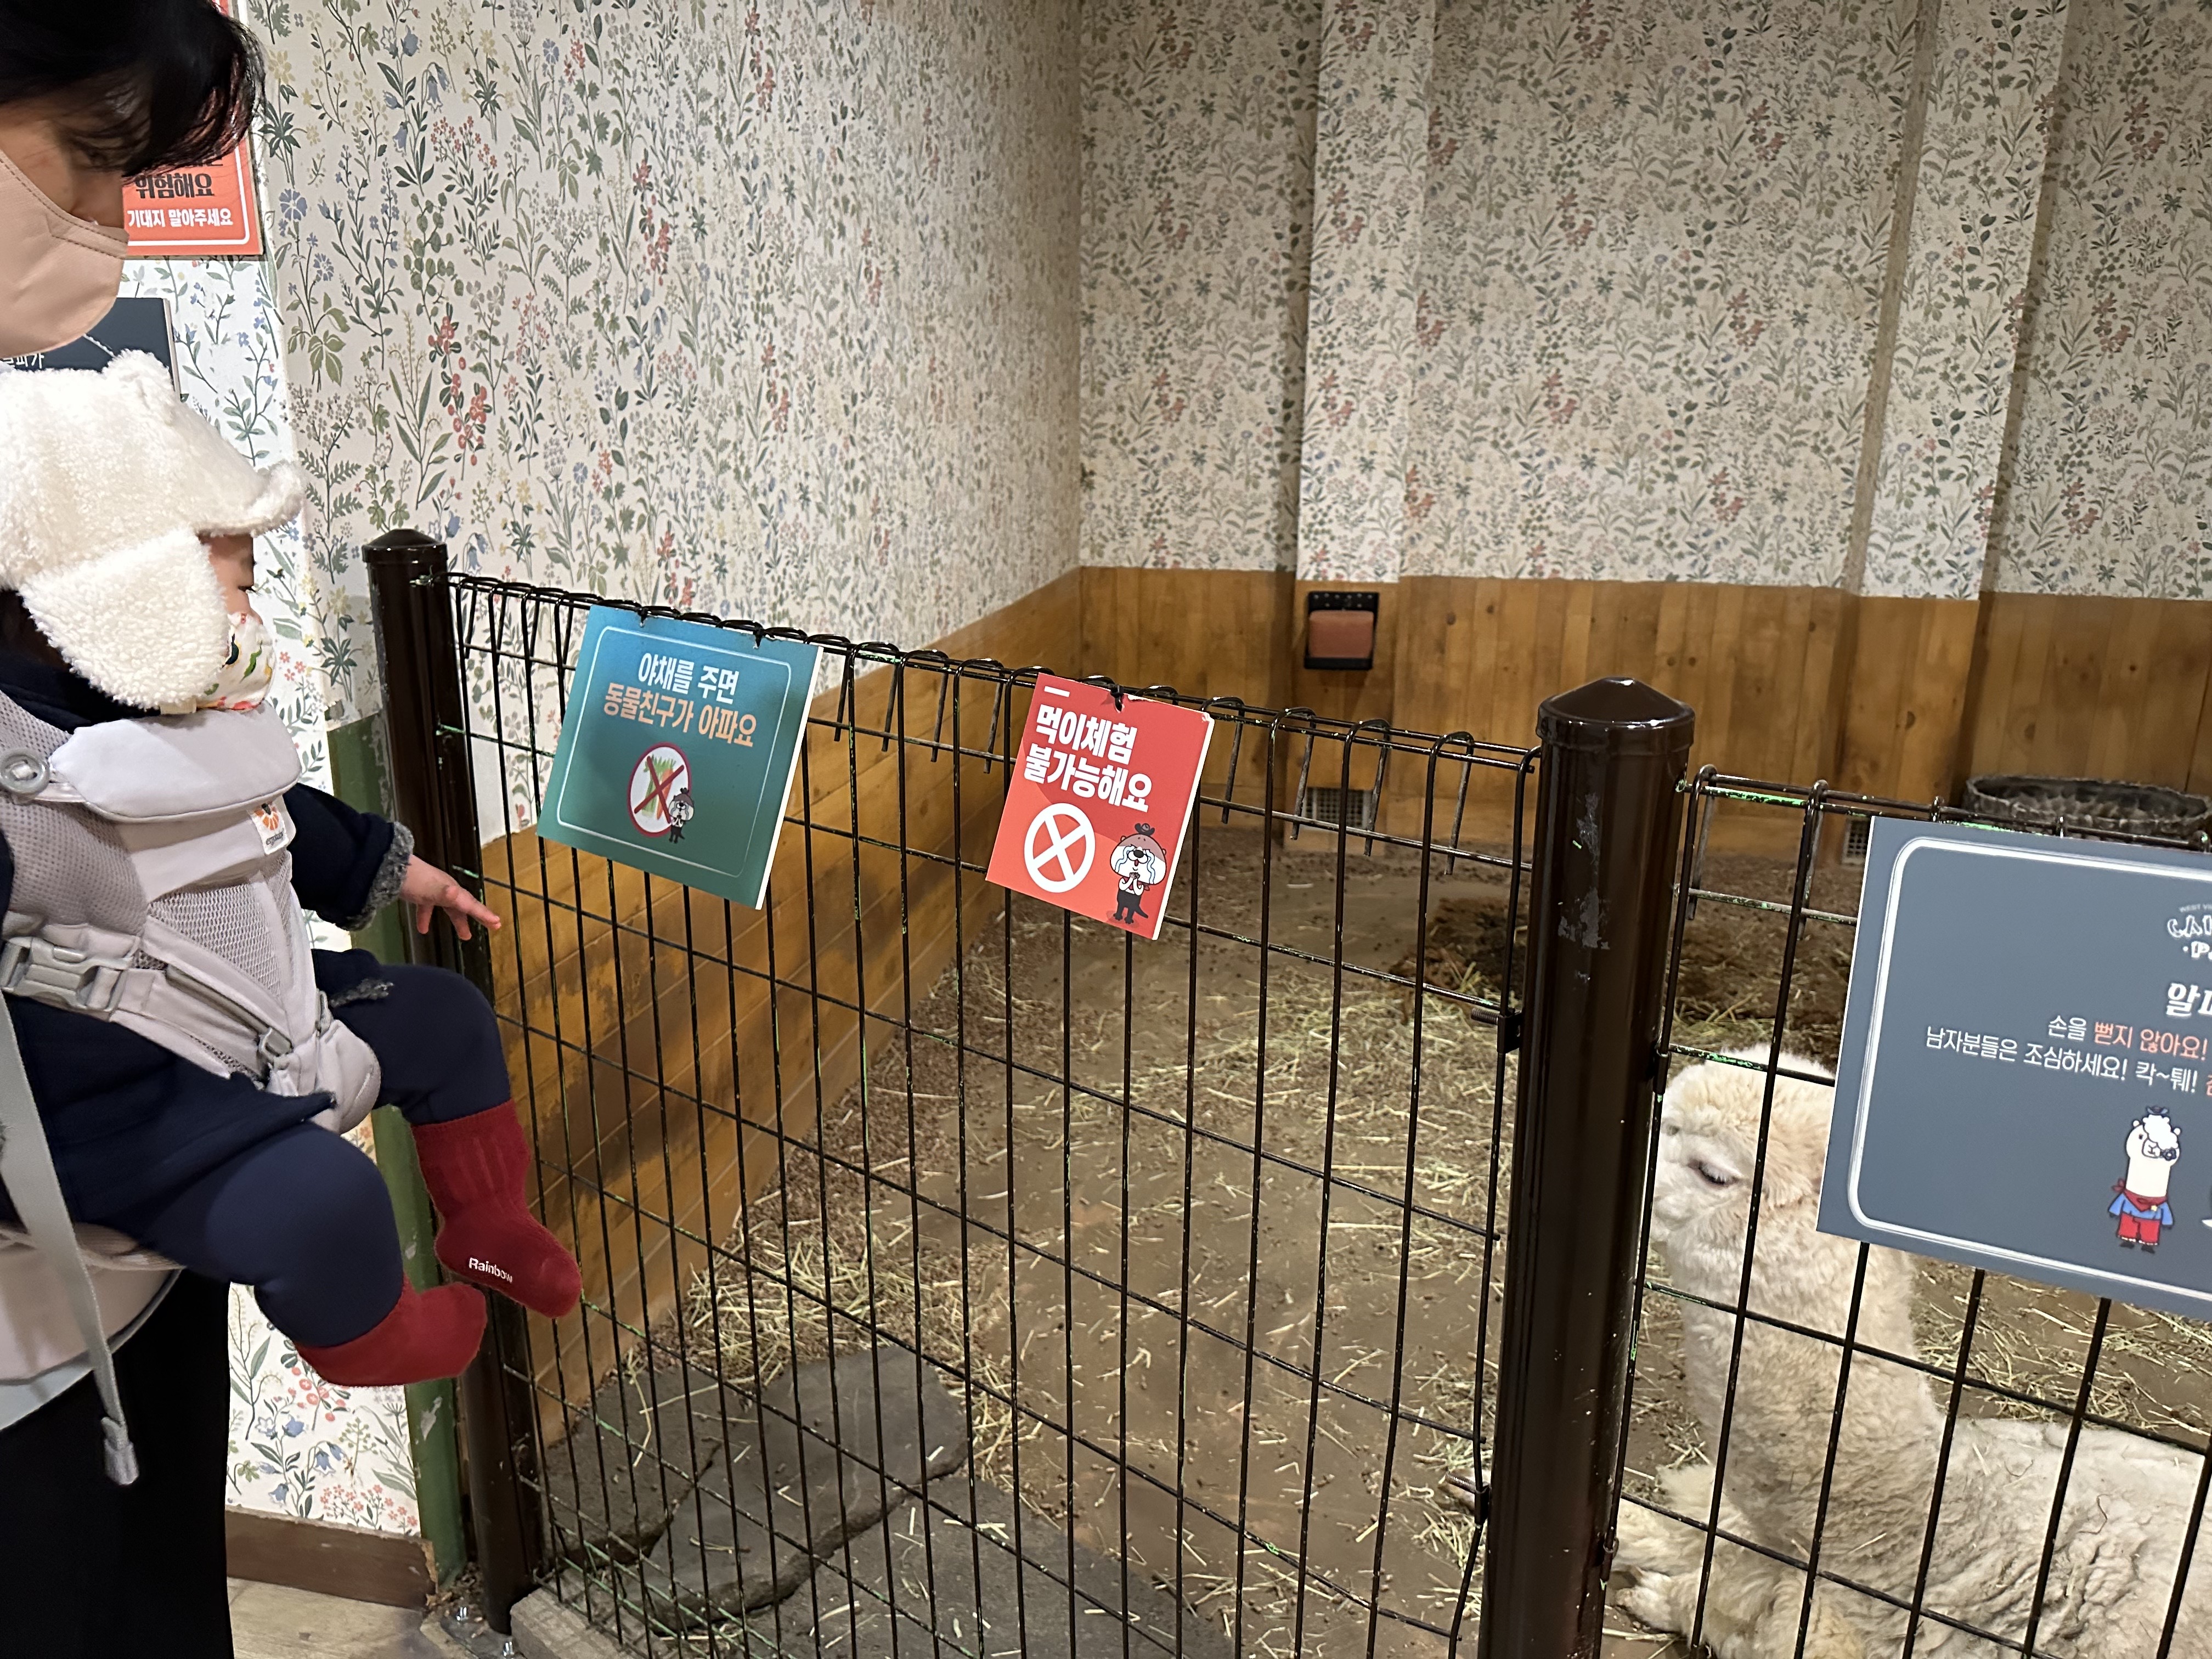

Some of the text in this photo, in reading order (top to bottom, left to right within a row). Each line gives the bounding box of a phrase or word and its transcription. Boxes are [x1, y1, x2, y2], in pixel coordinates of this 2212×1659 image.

[135, 172, 215, 198] 위험해요
[127, 208, 233, 228] 기대지 말아주세요
[638, 653, 740, 704] 야채를 주면
[603, 682, 757, 747] 동물친구가 아파요
[1035, 704, 1138, 766] 먹이체험
[1023, 743, 1153, 812] 불가능해요
[1926, 1026, 2018, 1062] 남자분들은
[2023, 1042, 2129, 1081] 조심하세요!
[2048, 1015, 2208, 1062] 손을 뻗지 않아요!
[469, 1257, 514, 1284] Rainbow
